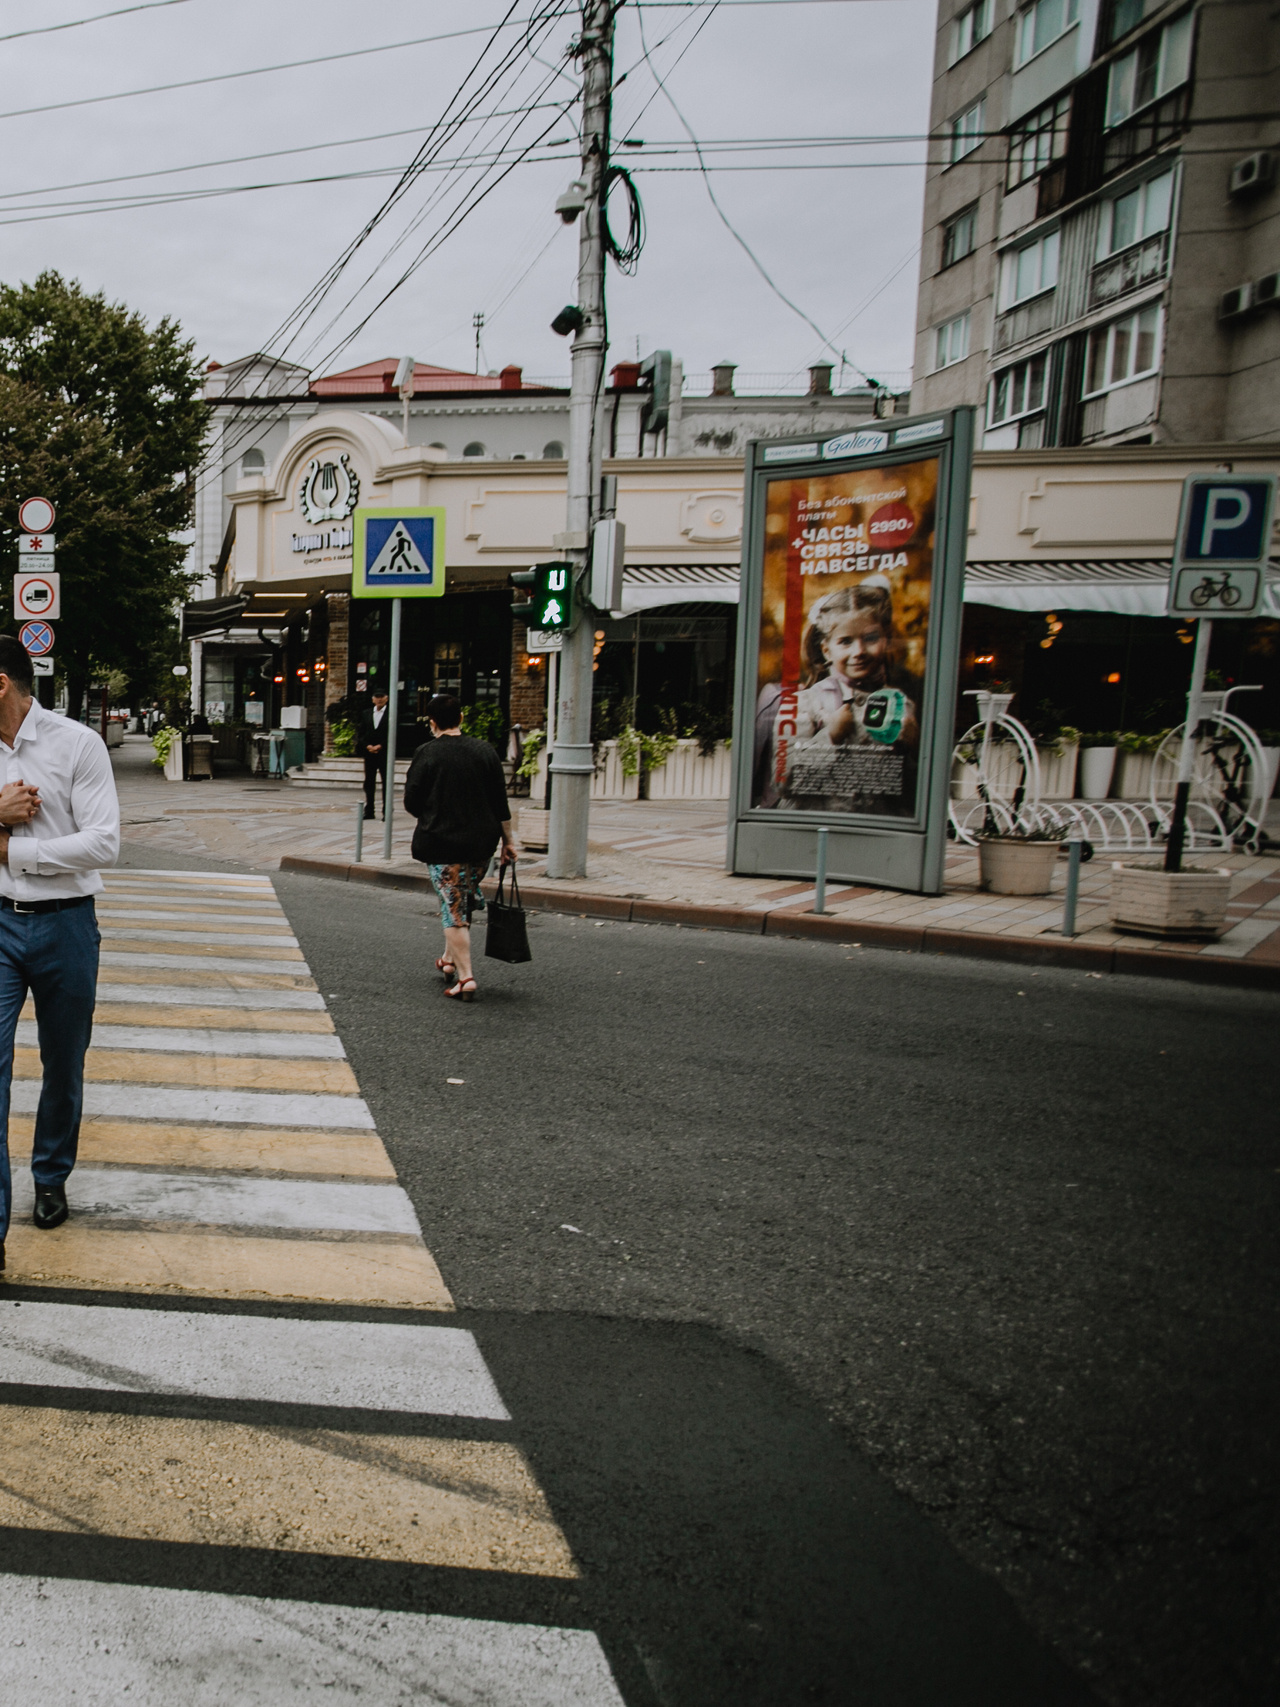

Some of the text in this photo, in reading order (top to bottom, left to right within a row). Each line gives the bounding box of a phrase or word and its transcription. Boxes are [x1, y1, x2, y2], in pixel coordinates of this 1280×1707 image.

[827, 434, 883, 455] Gallery
[798, 486, 907, 511] Без абонентской
[797, 511, 837, 522] платы
[1200, 488, 1252, 556] P
[802, 523, 864, 543] ЧАСЫ
[800, 540, 869, 559] СВЯЗЬ
[800, 552, 908, 575] НАВСЕГДА
